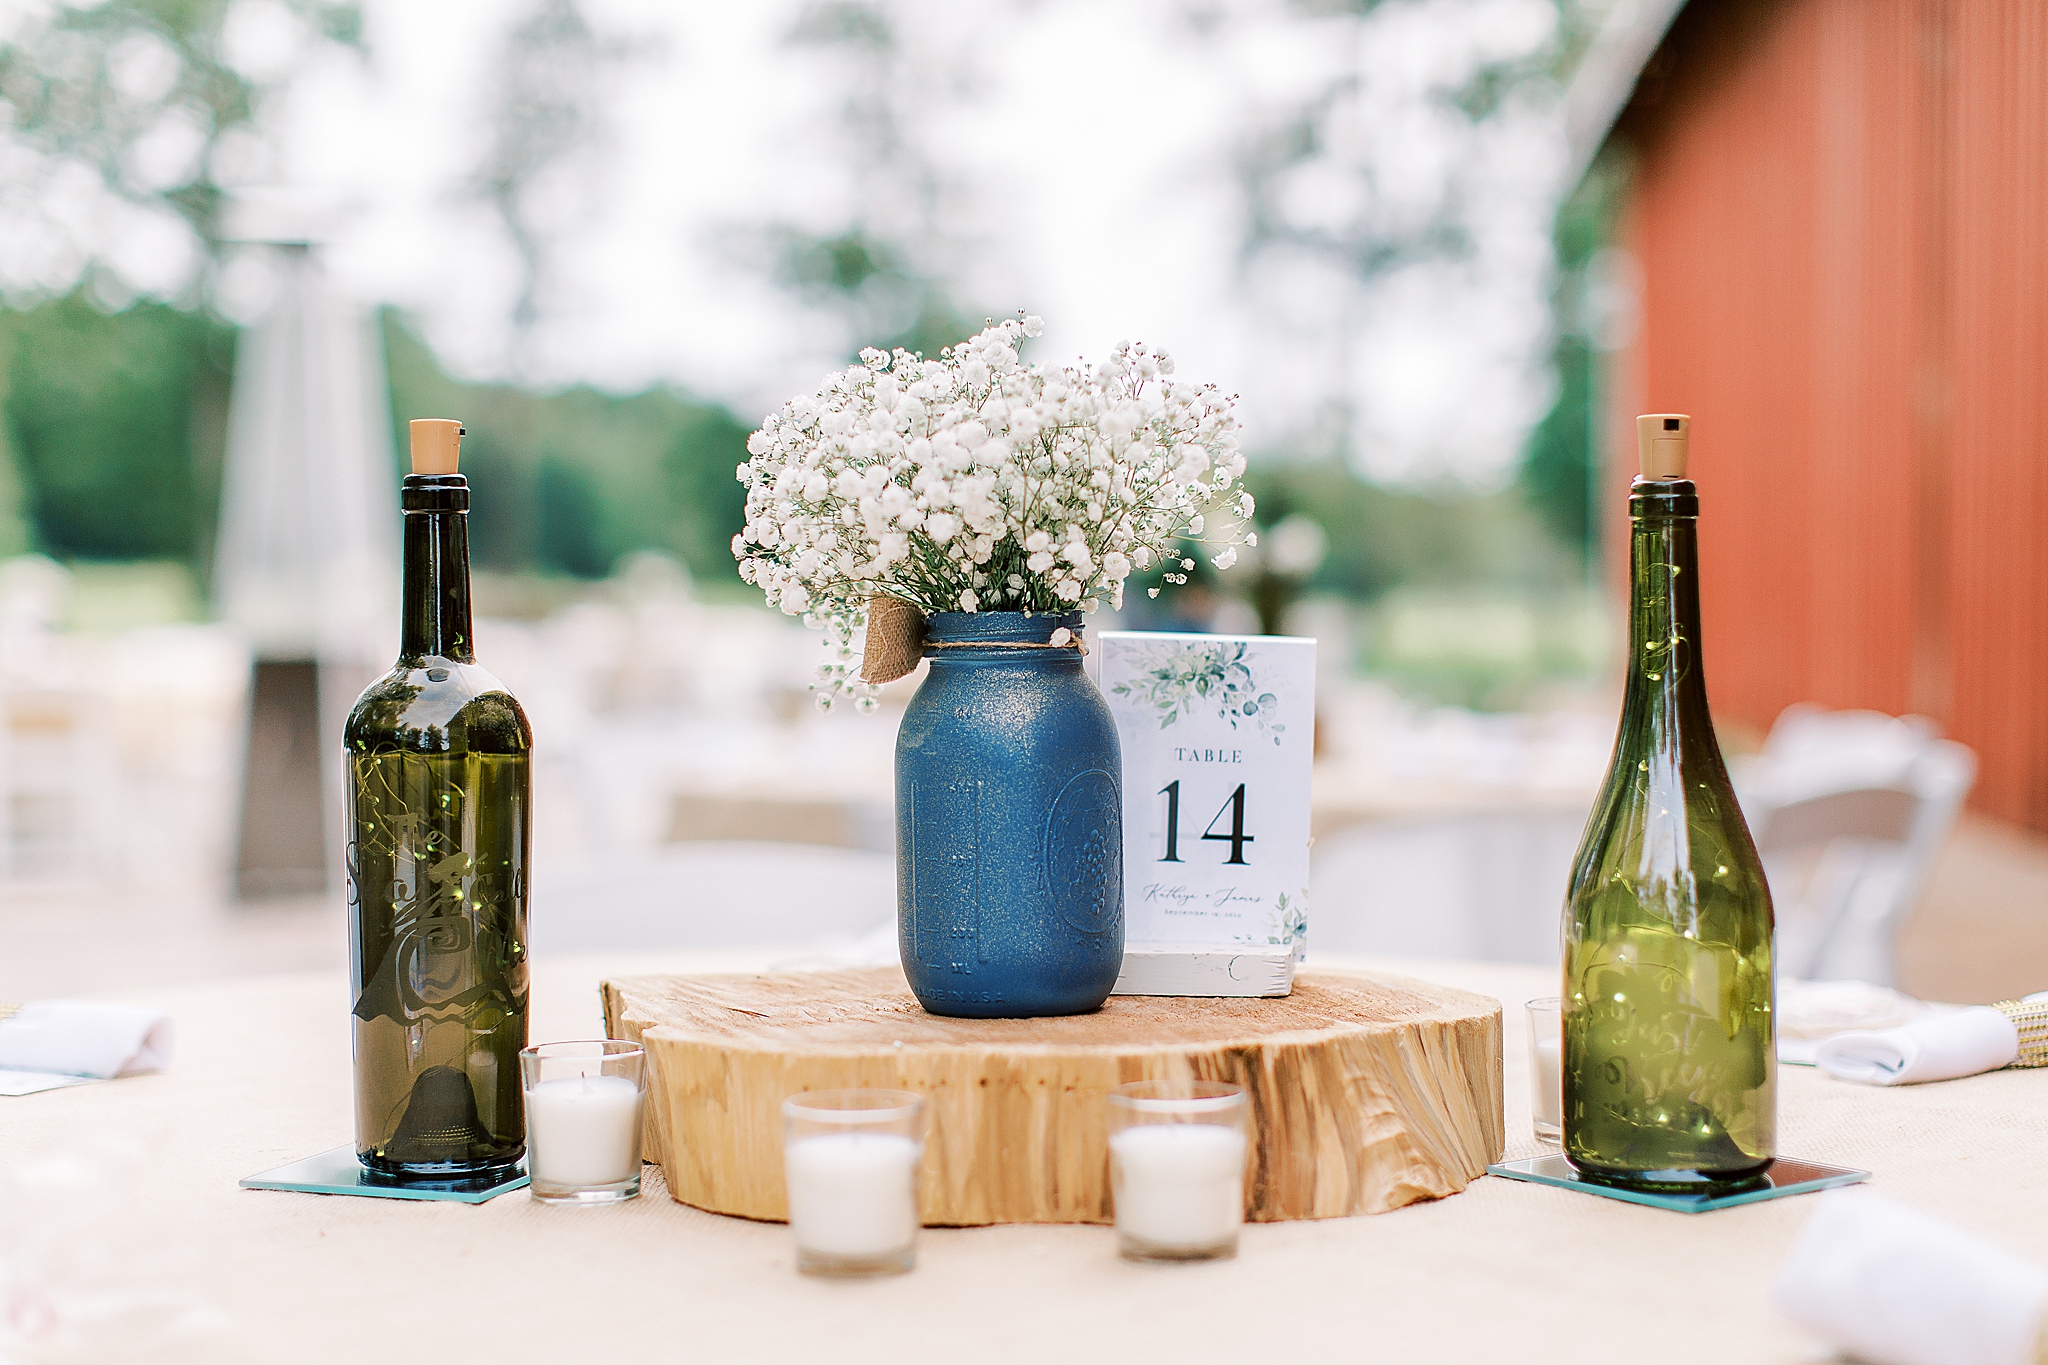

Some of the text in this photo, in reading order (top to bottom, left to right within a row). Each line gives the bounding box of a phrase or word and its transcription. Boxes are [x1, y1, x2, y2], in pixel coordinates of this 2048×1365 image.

[1174, 747, 1242, 764] TABLE
[1157, 779, 1255, 866] 14
[1143, 883, 1198, 907] Kathryn
[1214, 886, 1264, 907] James
[1164, 908, 1209, 917] September
[915, 987, 947, 1002] MADE
[948, 990, 966, 1003] IN
